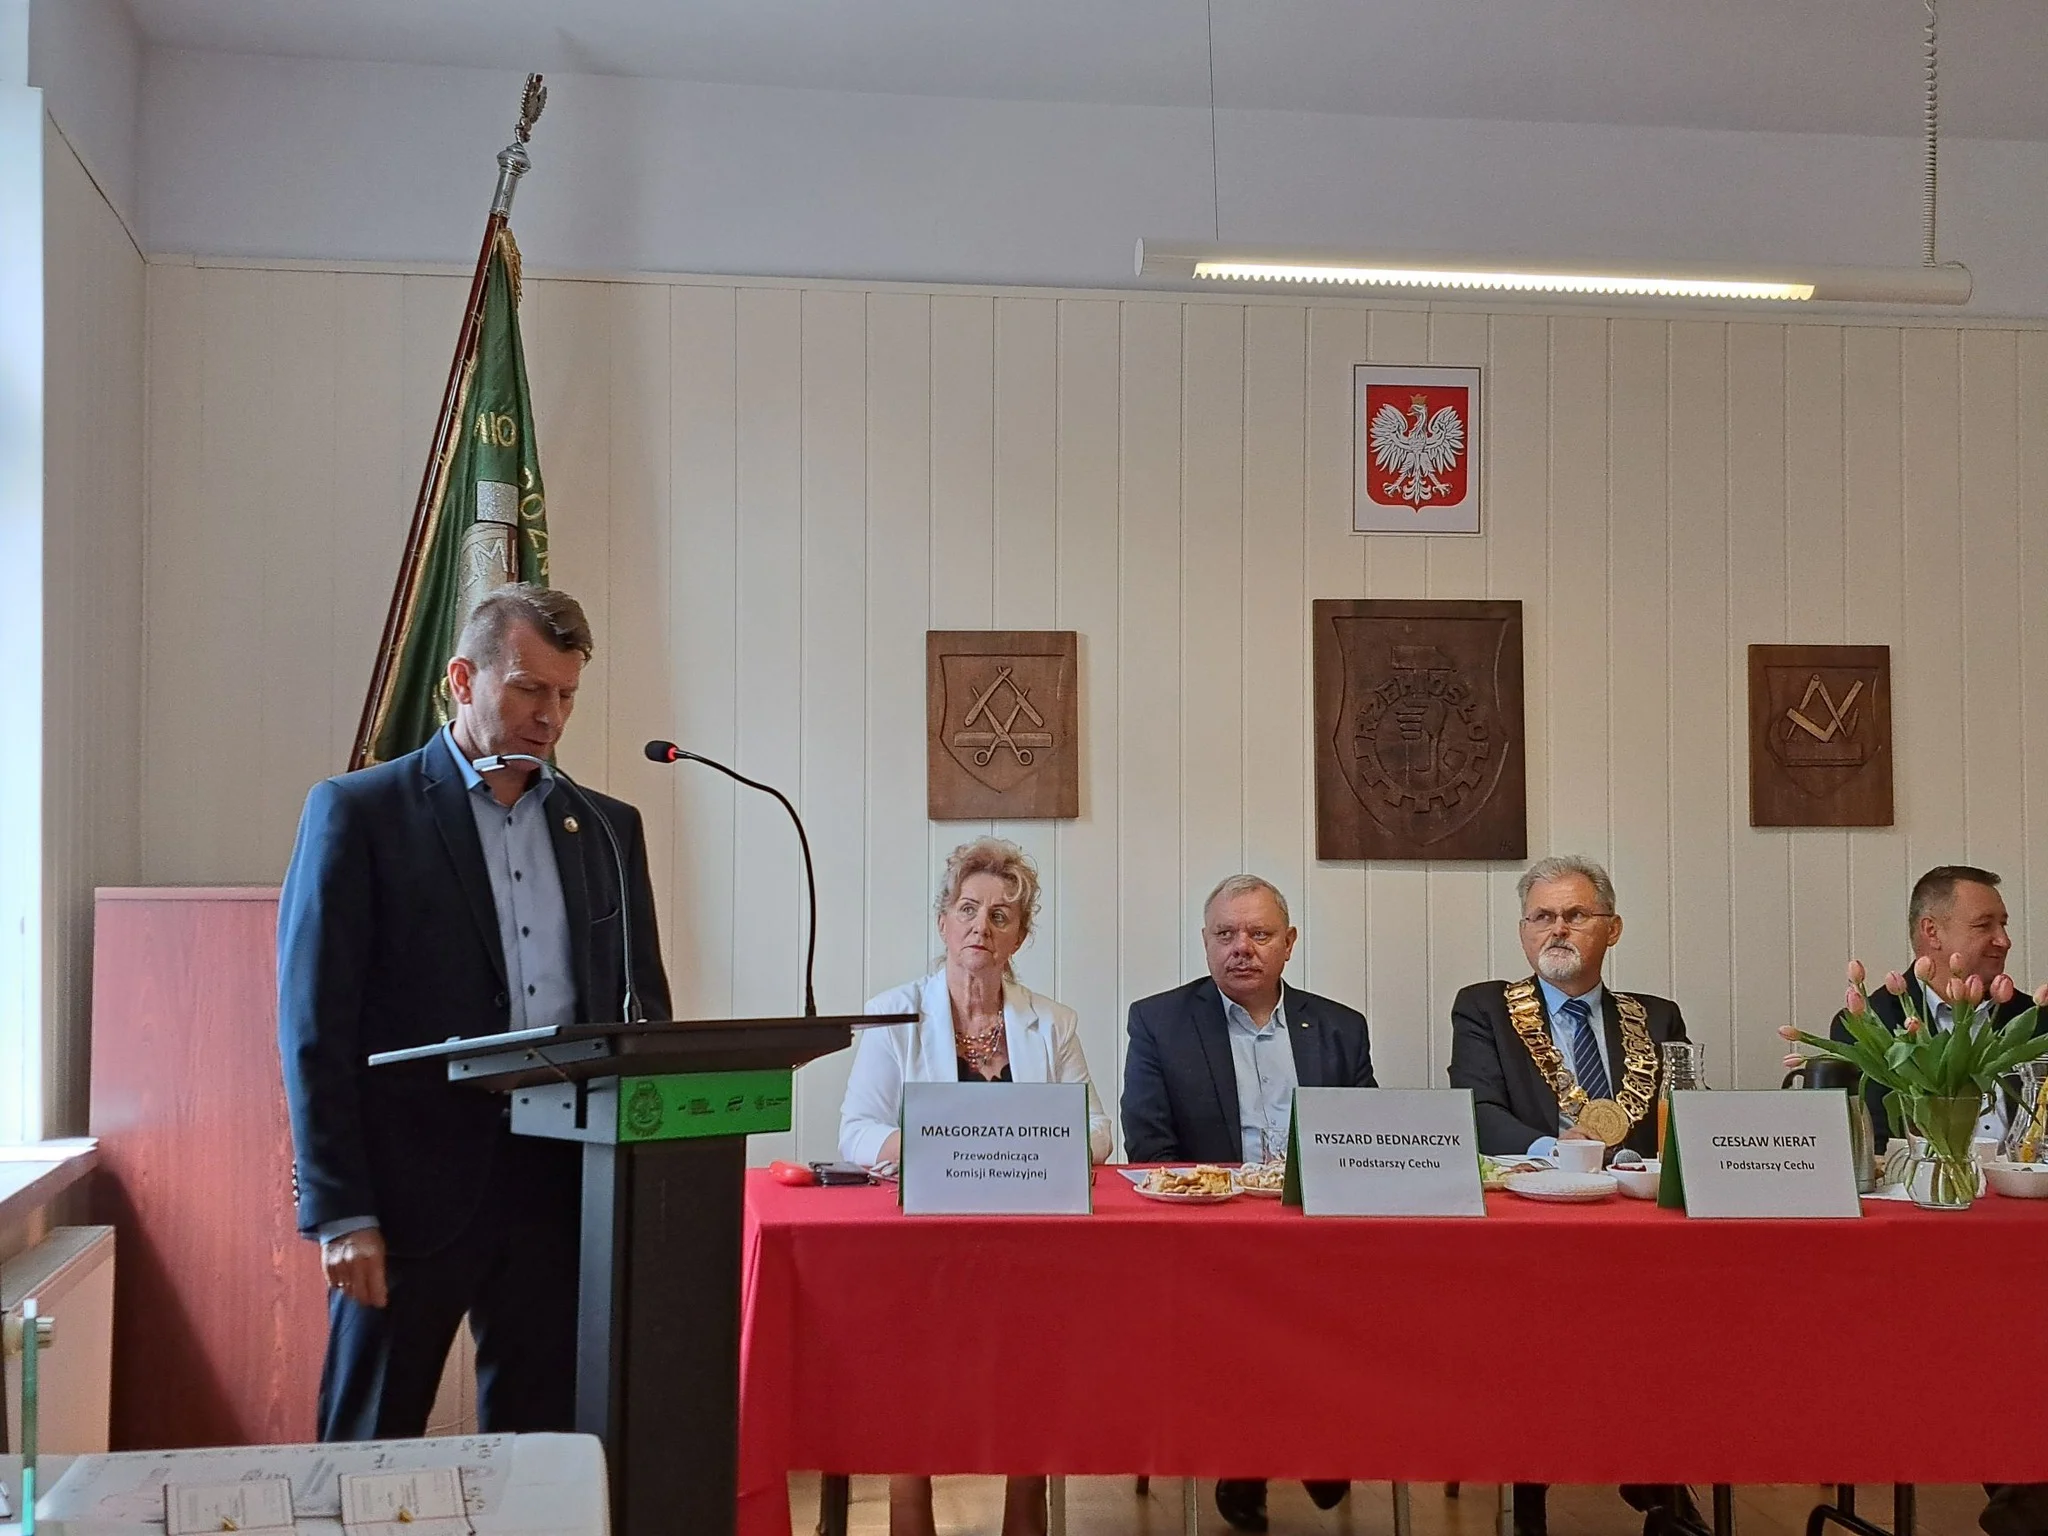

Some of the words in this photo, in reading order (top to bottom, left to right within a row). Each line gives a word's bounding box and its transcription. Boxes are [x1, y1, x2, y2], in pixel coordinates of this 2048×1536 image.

[921, 1125, 1014, 1137] MAŁGORZATA
[1018, 1126, 1070, 1138] DITRICH
[1314, 1133, 1372, 1145] RYSZARD
[1376, 1134, 1461, 1146] BEDNARCZYK
[1712, 1136, 1769, 1147] CZESŁAW
[1773, 1136, 1817, 1147] KIERAT
[953, 1151, 1039, 1163] Przewodnicząca
[1339, 1158, 1346, 1167] II
[1349, 1158, 1405, 1170] Podstarszy
[1408, 1158, 1441, 1169] Cechu
[1726, 1160, 1781, 1172] Podstarszy
[1783, 1160, 1815, 1170] Cechu
[946, 1168, 986, 1180] Komisji
[989, 1168, 1048, 1180] Rewizyjnej
